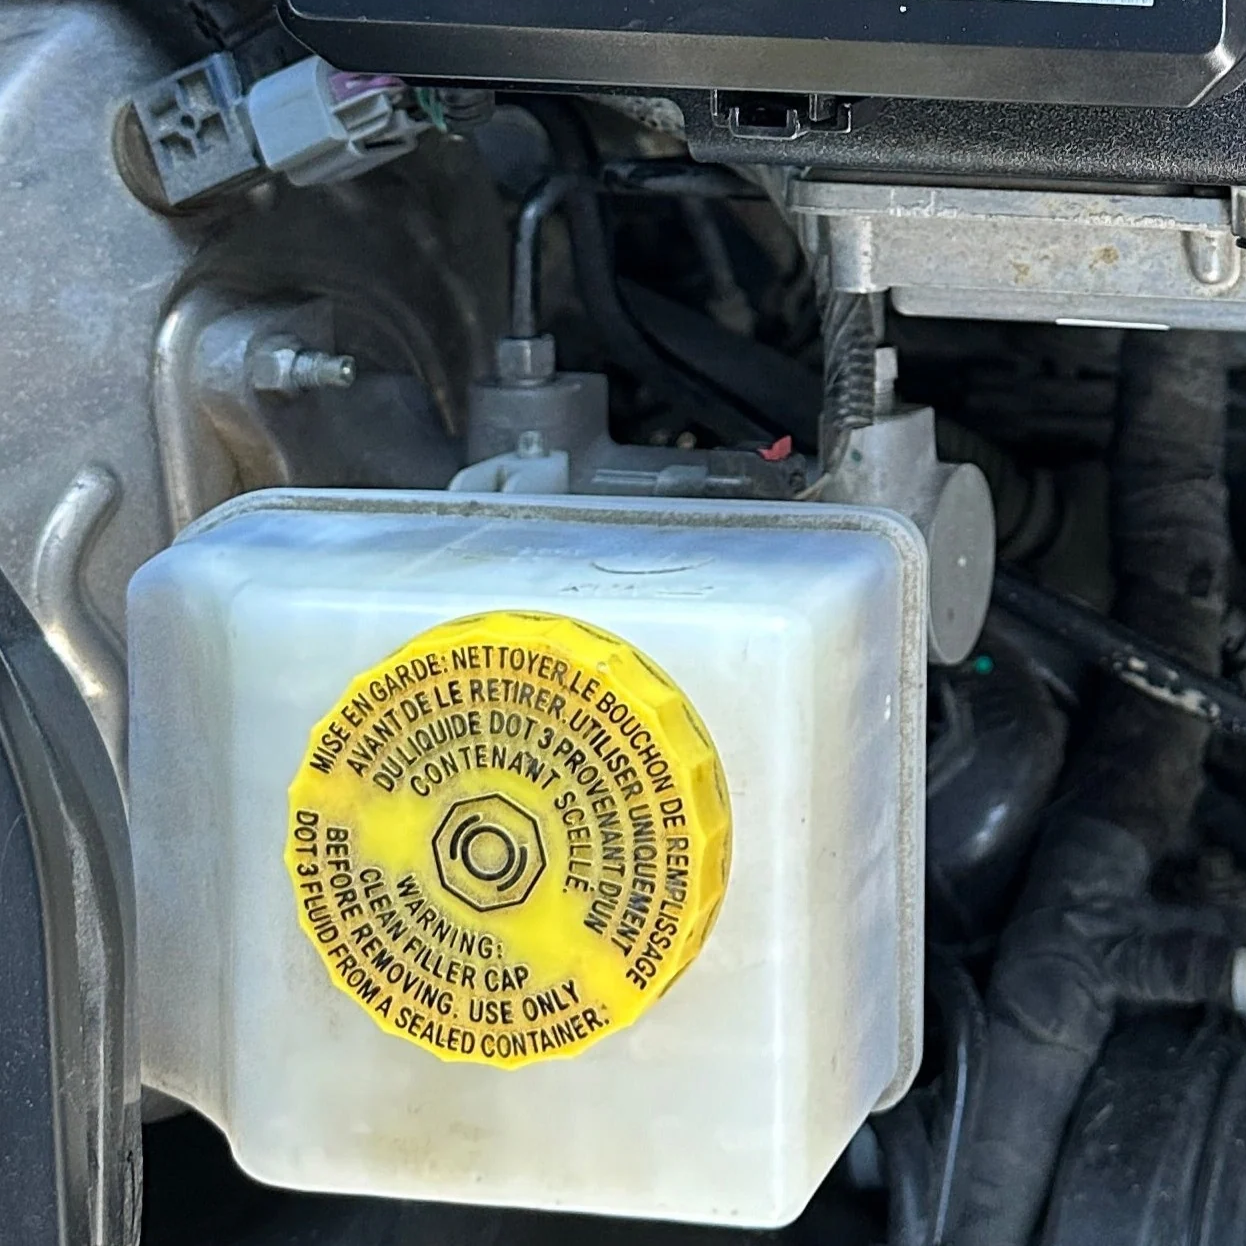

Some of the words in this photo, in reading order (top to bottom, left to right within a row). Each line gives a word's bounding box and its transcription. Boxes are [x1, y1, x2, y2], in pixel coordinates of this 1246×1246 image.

[369, 653, 448, 702] GARDE:
[451, 645, 568, 686] NETTOYER
[569, 670, 600, 702] LE
[341, 693, 374, 727] EN
[489, 710, 538, 740] DOT
[310, 721, 350, 774] MISE
[396, 711, 482, 766] LIQUIDE
[537, 727, 555, 749] 3
[595, 691, 674, 793] BOUCHON
[372, 755, 404, 793] DU
[410, 744, 561, 796] CONTENANT
[346, 708, 403, 778] AVANT
[400, 691, 433, 723] DE
[433, 680, 463, 708] LE
[469, 678, 566, 724] RETIRER.
[569, 708, 644, 802] UTILISER
[611, 804, 657, 957] UNIQUEMENT
[552, 737, 626, 877] PROVENANT
[660, 797, 686, 830] DE
[293, 810, 319, 857] DOT
[297, 863, 319, 876] 3
[301, 881, 339, 944] FLUID
[326, 827, 363, 921] BEFORE
[351, 922, 458, 1019] REMOVING.
[469, 999, 513, 1025] USE
[522, 980, 580, 1022] ONLY
[359, 867, 408, 941] CLEAN
[402, 935, 476, 990] FILLER
[484, 965, 529, 992] CAP
[397, 874, 502, 959] WARNING:
[584, 880, 623, 935] D'UN
[626, 836, 689, 990] REMPLISSAGE
[327, 943, 381, 1004] FROM
[375, 995, 393, 1018] A
[395, 1006, 475, 1055] SEALED
[481, 1007, 610, 1058] CONTAINER.
